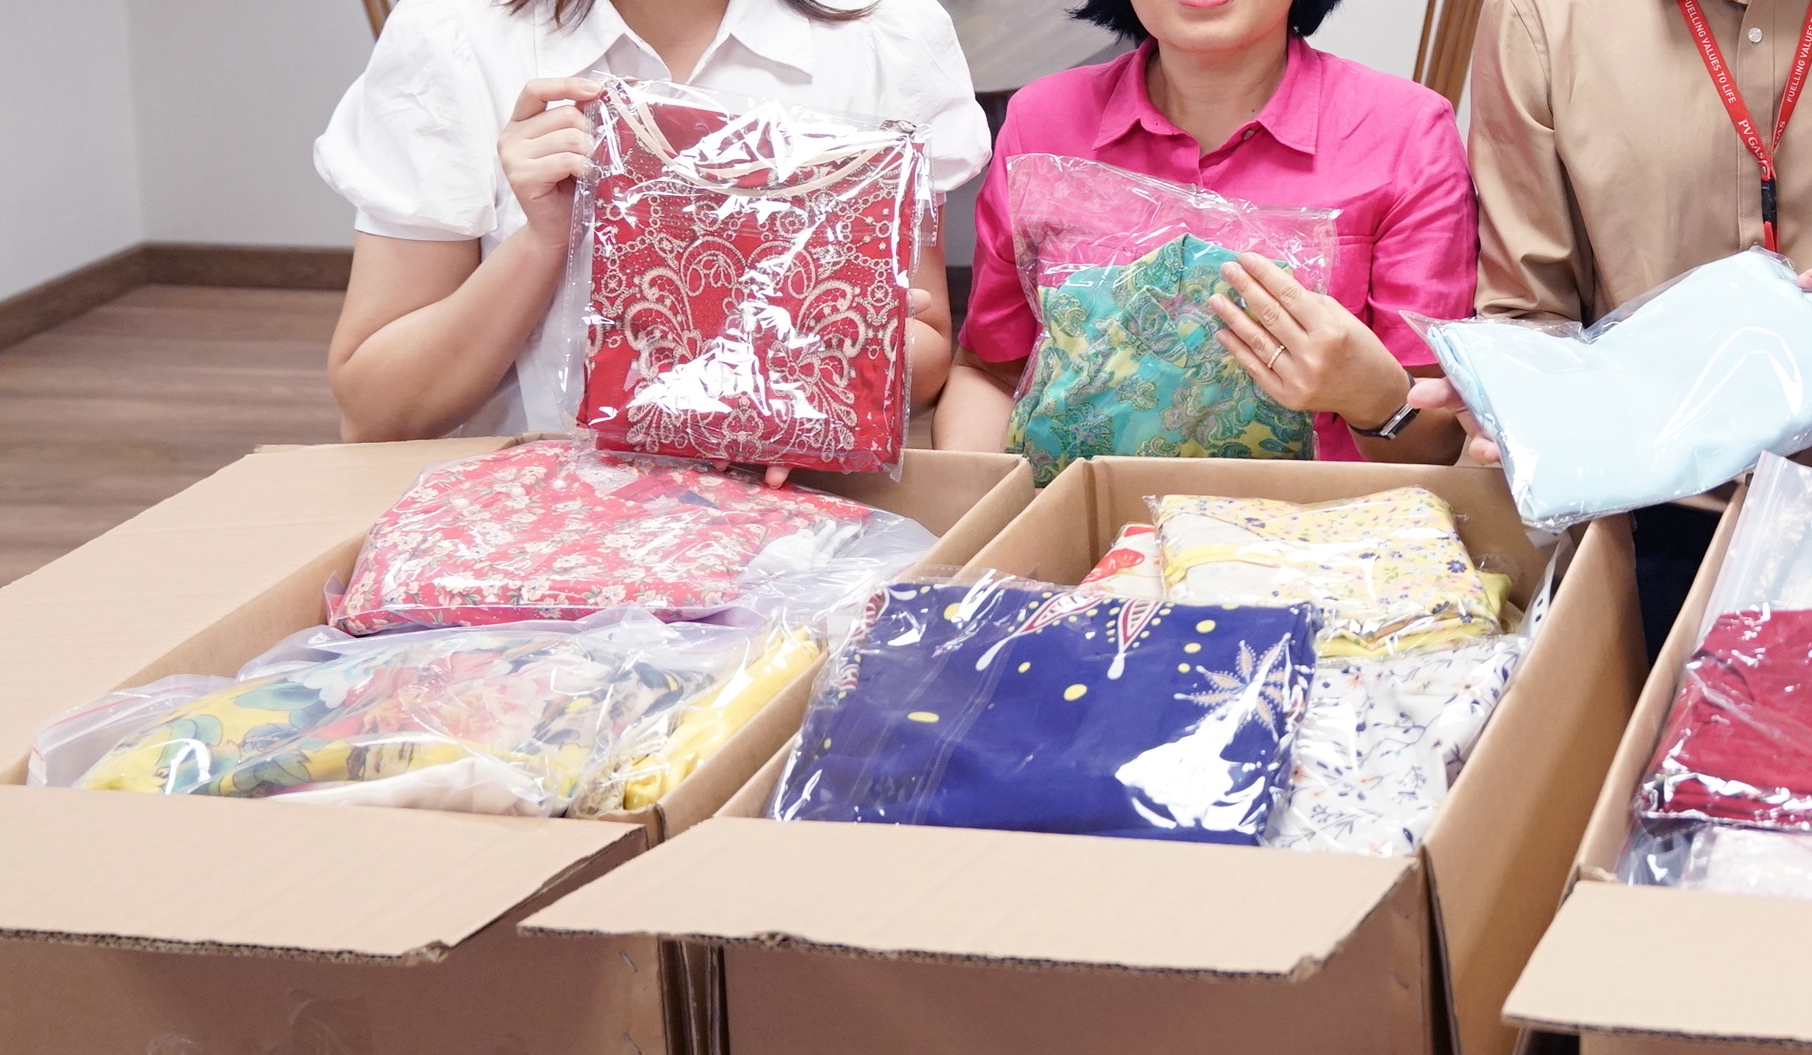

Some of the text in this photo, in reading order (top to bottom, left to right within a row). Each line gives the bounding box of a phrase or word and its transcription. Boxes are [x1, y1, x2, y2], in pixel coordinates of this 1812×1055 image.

[1700, 37, 1720, 72] VALUES
[1716, 71, 1727, 84] TO
[1722, 83, 1737, 104] LIFE
[1787, 60, 1806, 103] FUELLING
[1738, 118, 1766, 160] PV GAS
